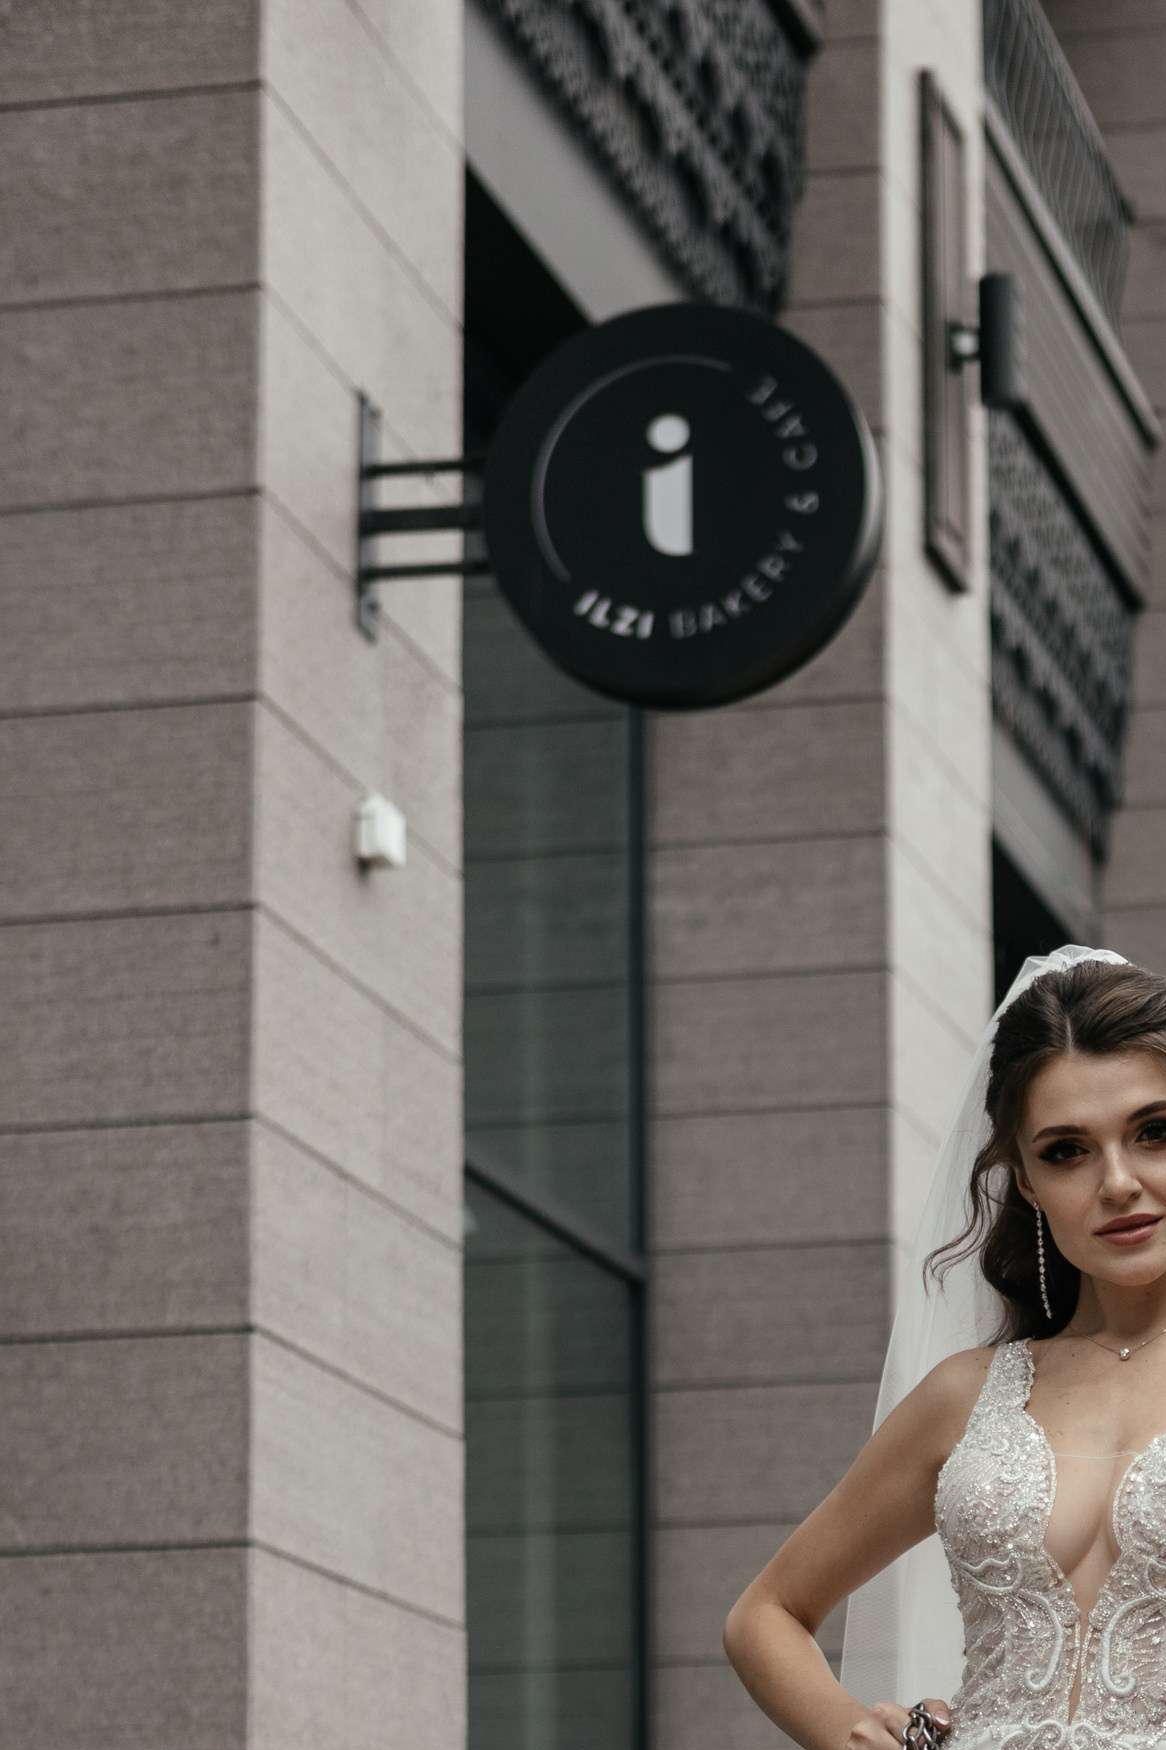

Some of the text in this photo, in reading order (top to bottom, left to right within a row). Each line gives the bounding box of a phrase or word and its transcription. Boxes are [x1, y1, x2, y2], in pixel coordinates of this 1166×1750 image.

[645, 414, 692, 557] i
[574, 590, 655, 640] ILZI
[669, 532, 802, 640] BAKERY
